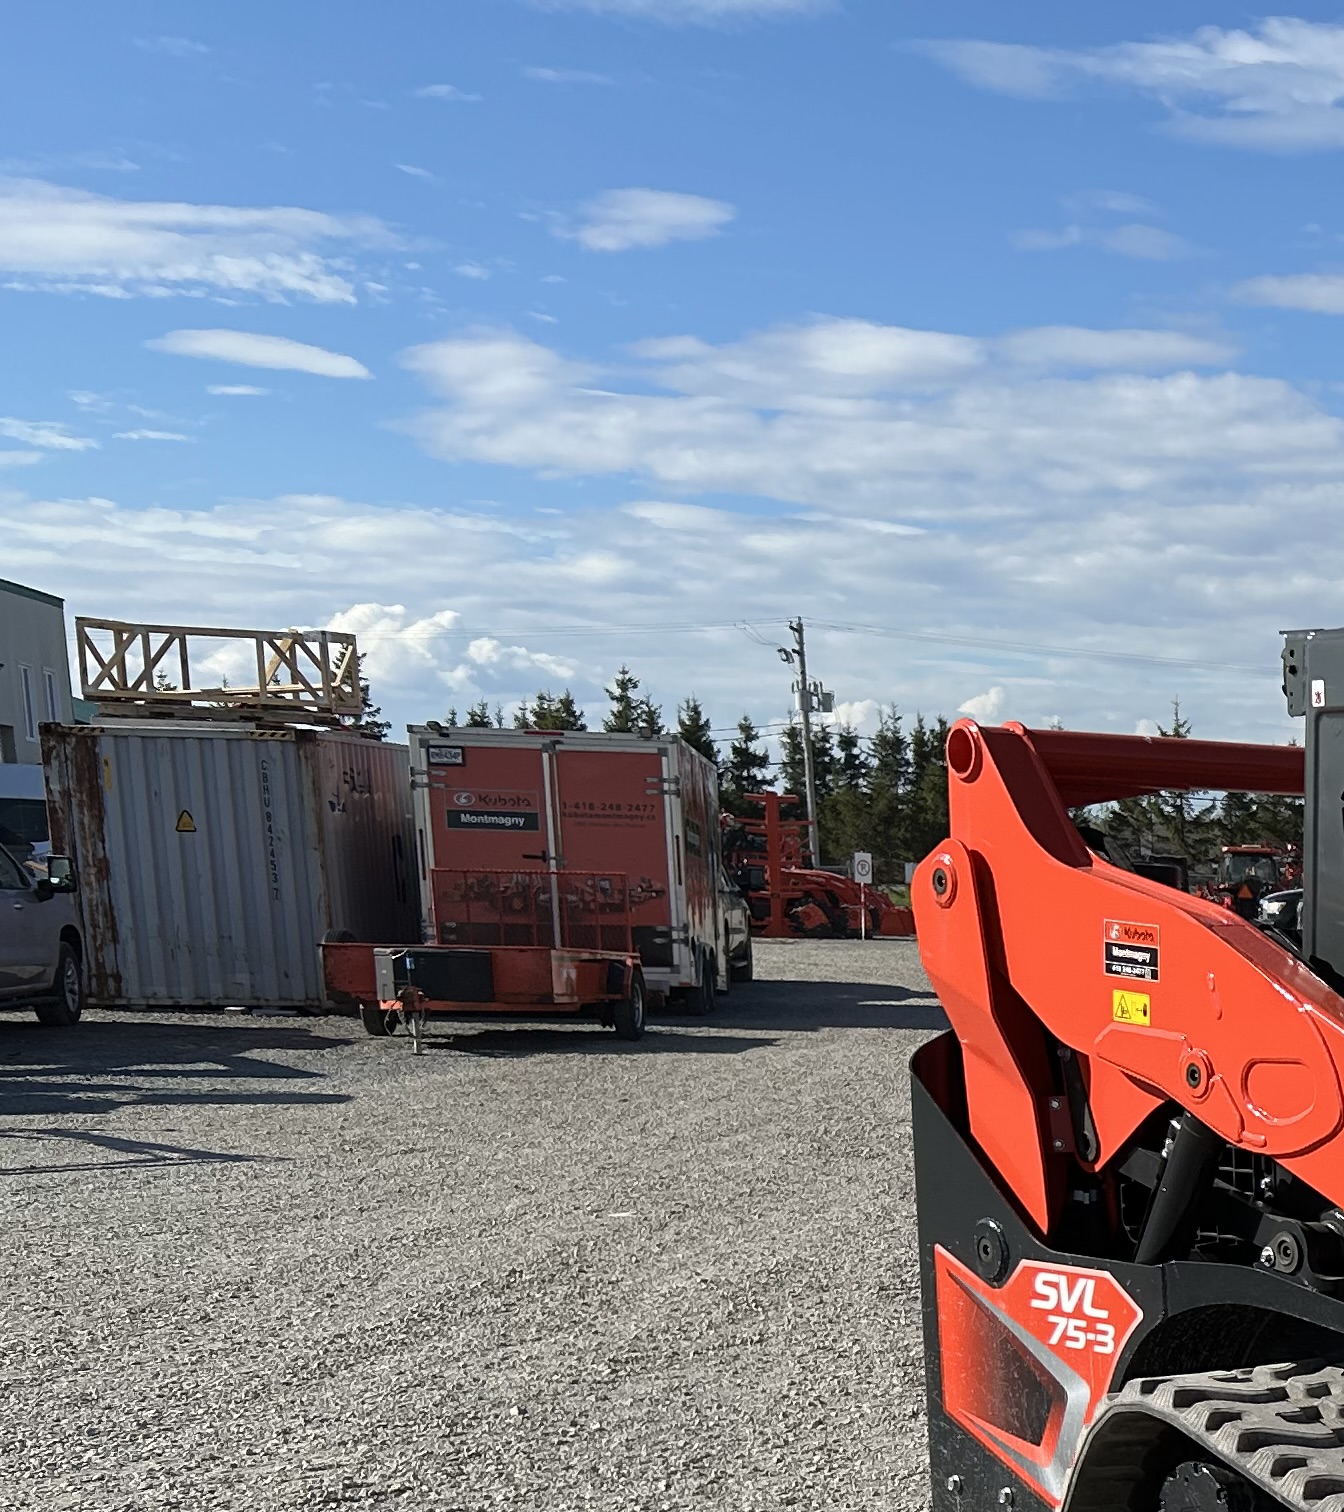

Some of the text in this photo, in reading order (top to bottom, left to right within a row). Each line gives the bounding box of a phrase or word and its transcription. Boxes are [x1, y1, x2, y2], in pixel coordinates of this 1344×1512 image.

[478, 794, 532, 808] Kubota
[561, 801, 656, 812] 1-418-248-2477
[460, 813, 526, 827] Montmagny
[1030, 1271, 1109, 1319] SVL
[1047, 1314, 1116, 1355] 75-3
